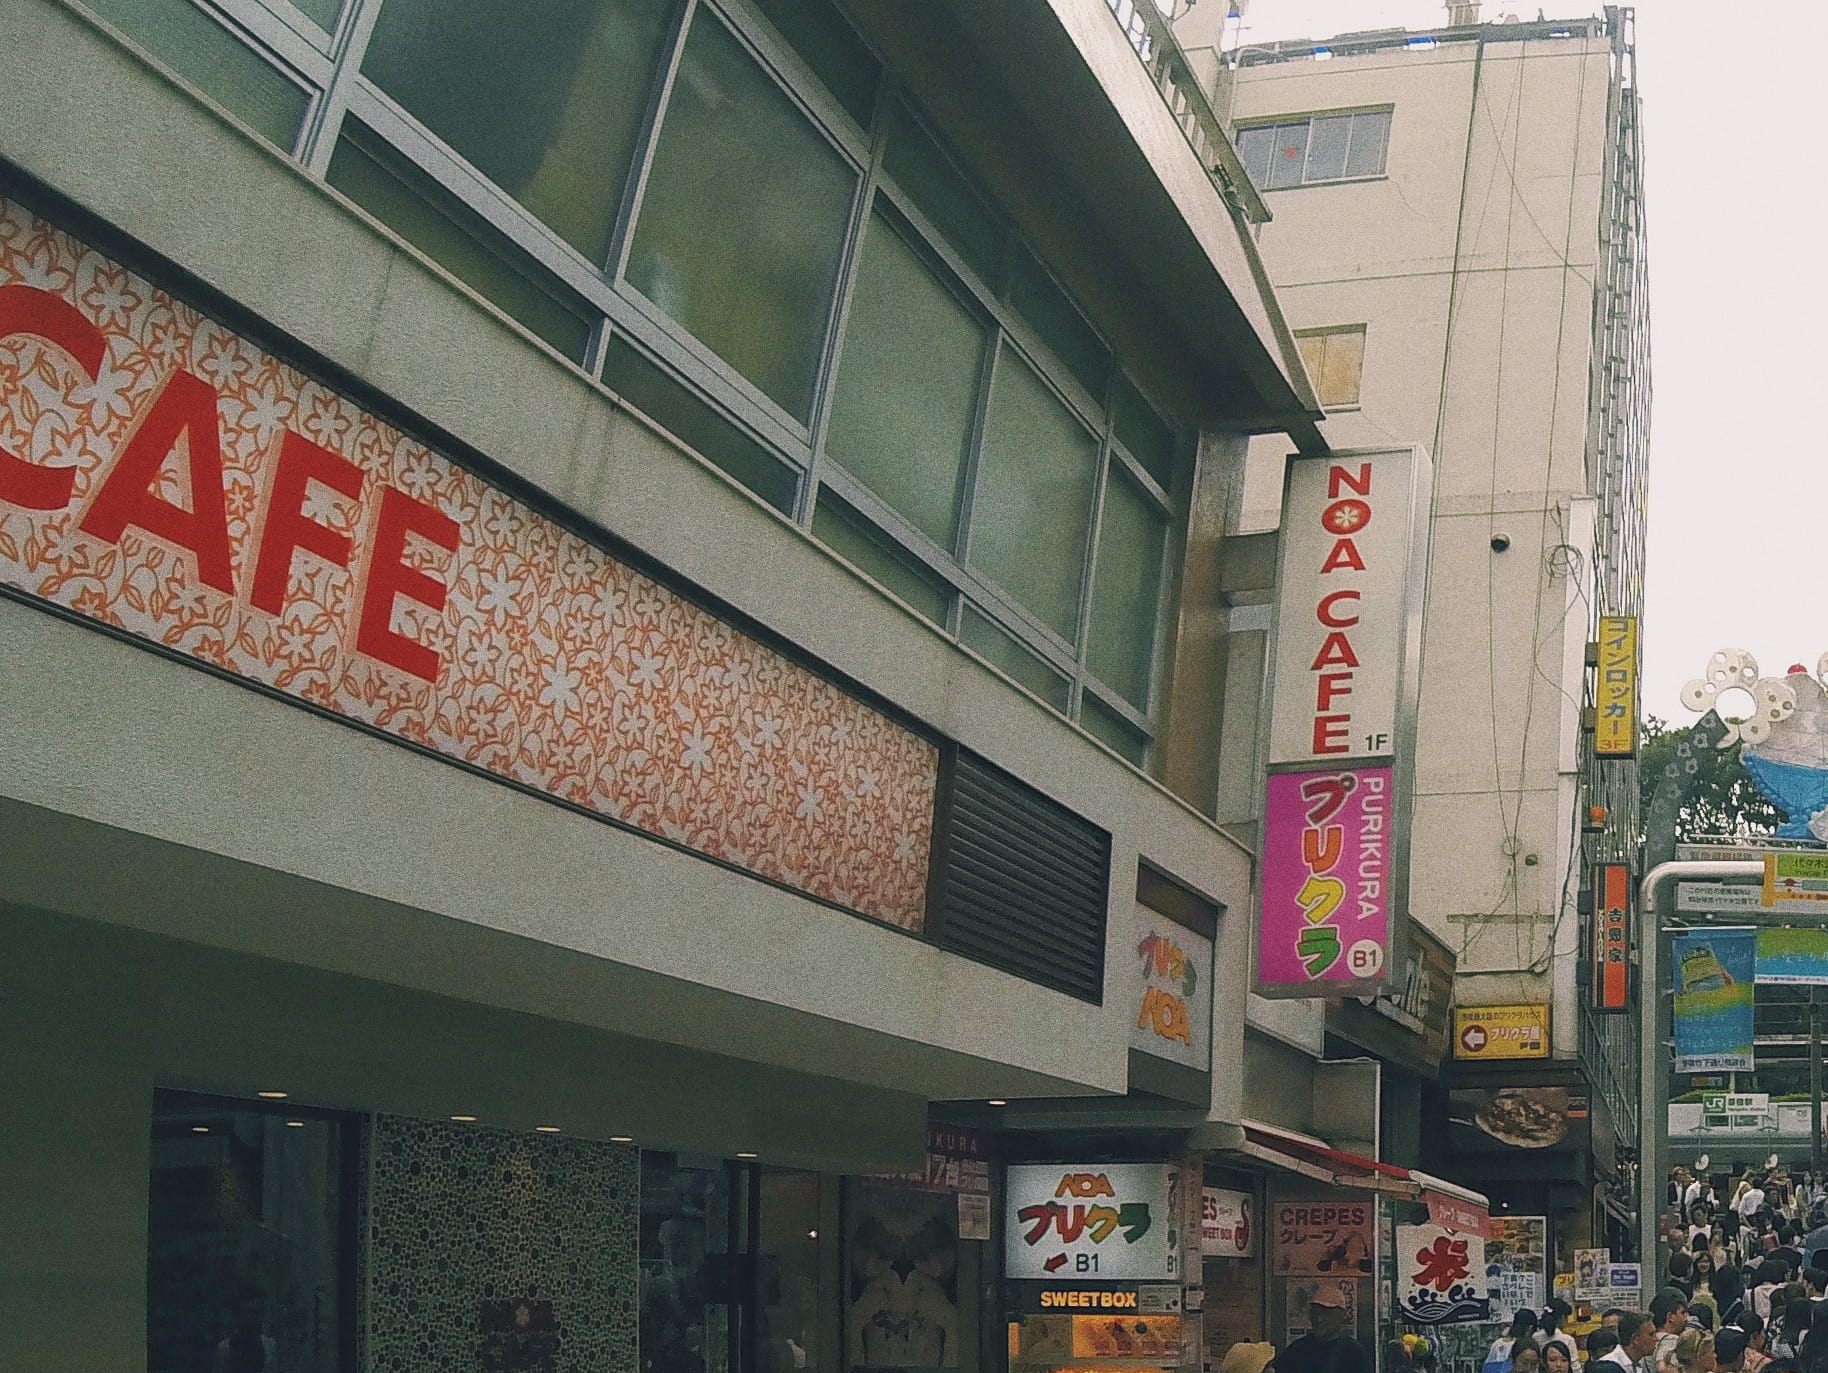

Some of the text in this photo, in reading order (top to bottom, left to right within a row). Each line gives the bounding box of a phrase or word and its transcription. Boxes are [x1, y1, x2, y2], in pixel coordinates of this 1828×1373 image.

[0, 284, 462, 684] CAFE
[1309, 462, 1373, 755] NOA CAFE
[1602, 618, 1632, 737] コインロッカー
[1365, 734, 1389, 752] 1F
[1599, 737, 1629, 750] 3F
[1356, 776, 1386, 921] PURIKURA
[1295, 771, 1359, 980] プリクラ
[1352, 950, 1377, 968] B1
[1706, 1099, 1724, 1109] JR
[1017, 1200, 1152, 1247] プリクラ
[1280, 1206, 1365, 1226] CREPES
[1076, 1253, 1100, 1273] B1
